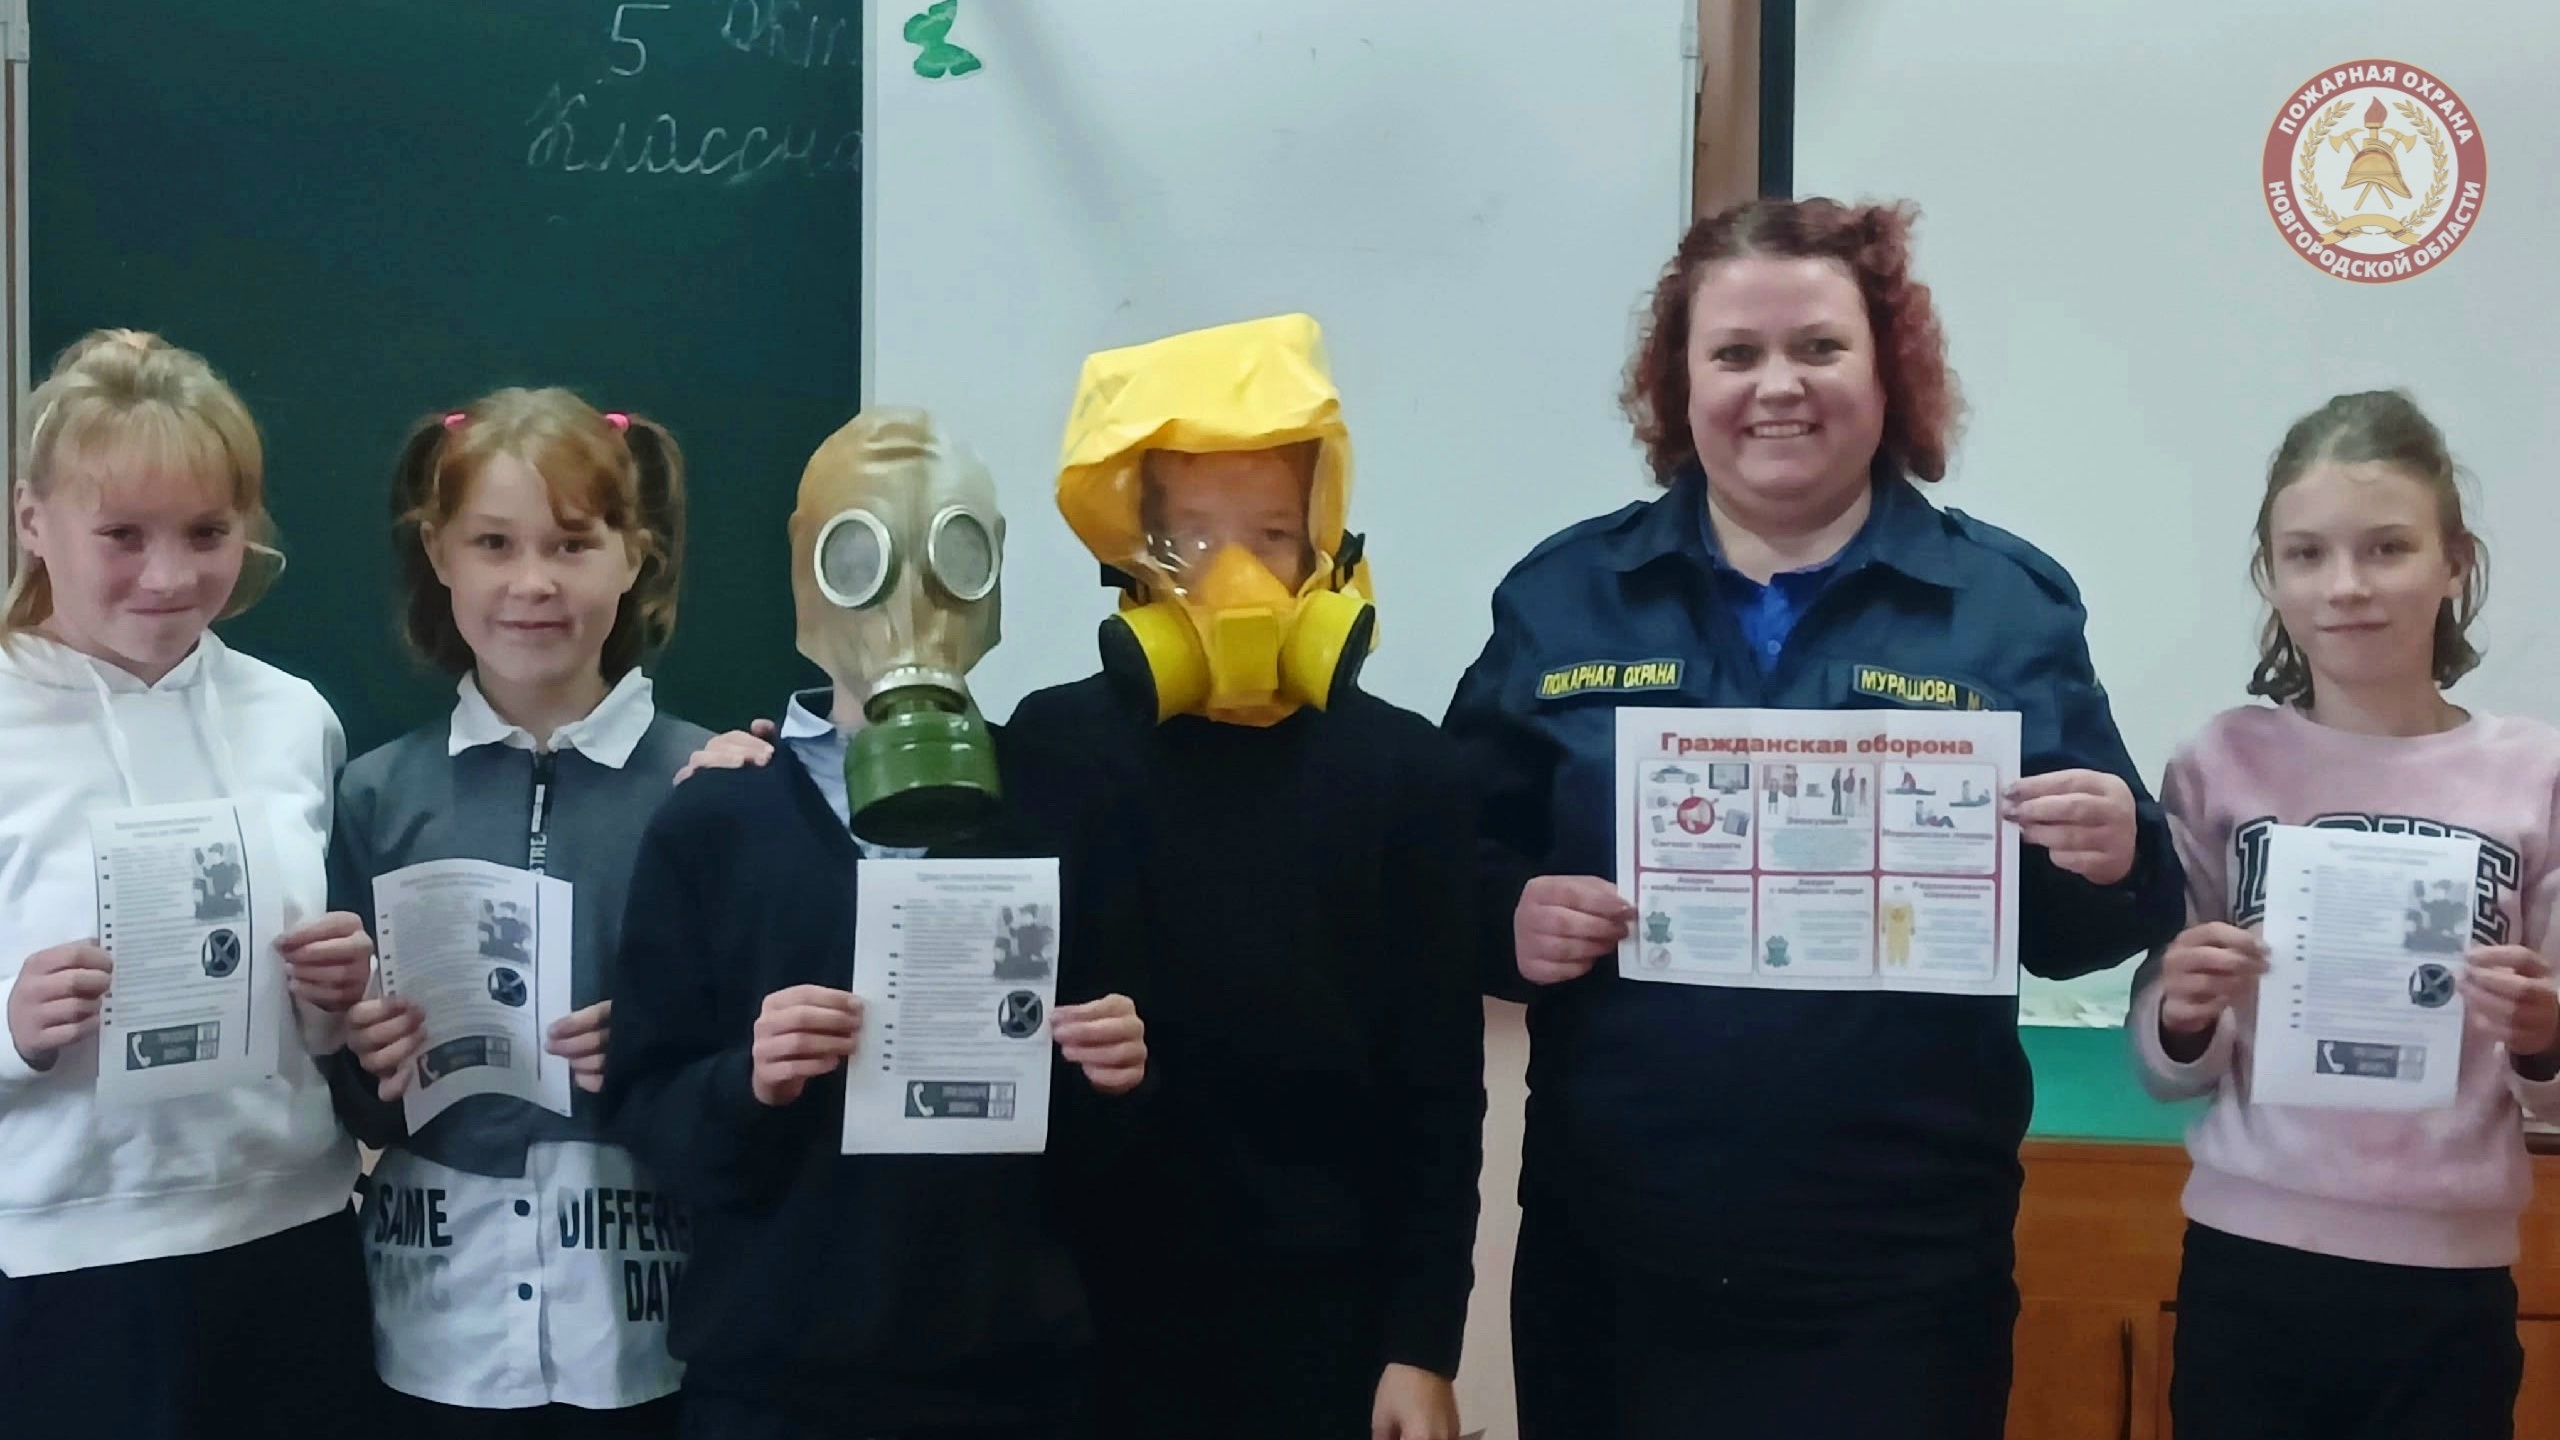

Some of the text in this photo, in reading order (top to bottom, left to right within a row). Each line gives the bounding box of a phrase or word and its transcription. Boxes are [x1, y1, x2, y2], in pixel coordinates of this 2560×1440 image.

[610, 3, 671, 76] 5
[1541, 663, 1676, 695] ПОЖАРНАЯ ОХРАНА
[1861, 669, 1957, 706] МУРАШОВА
[1661, 732, 1974, 758] Гражданская оборона
[375, 1184, 453, 1249] SAME
[623, 1259, 684, 1322] DAY
